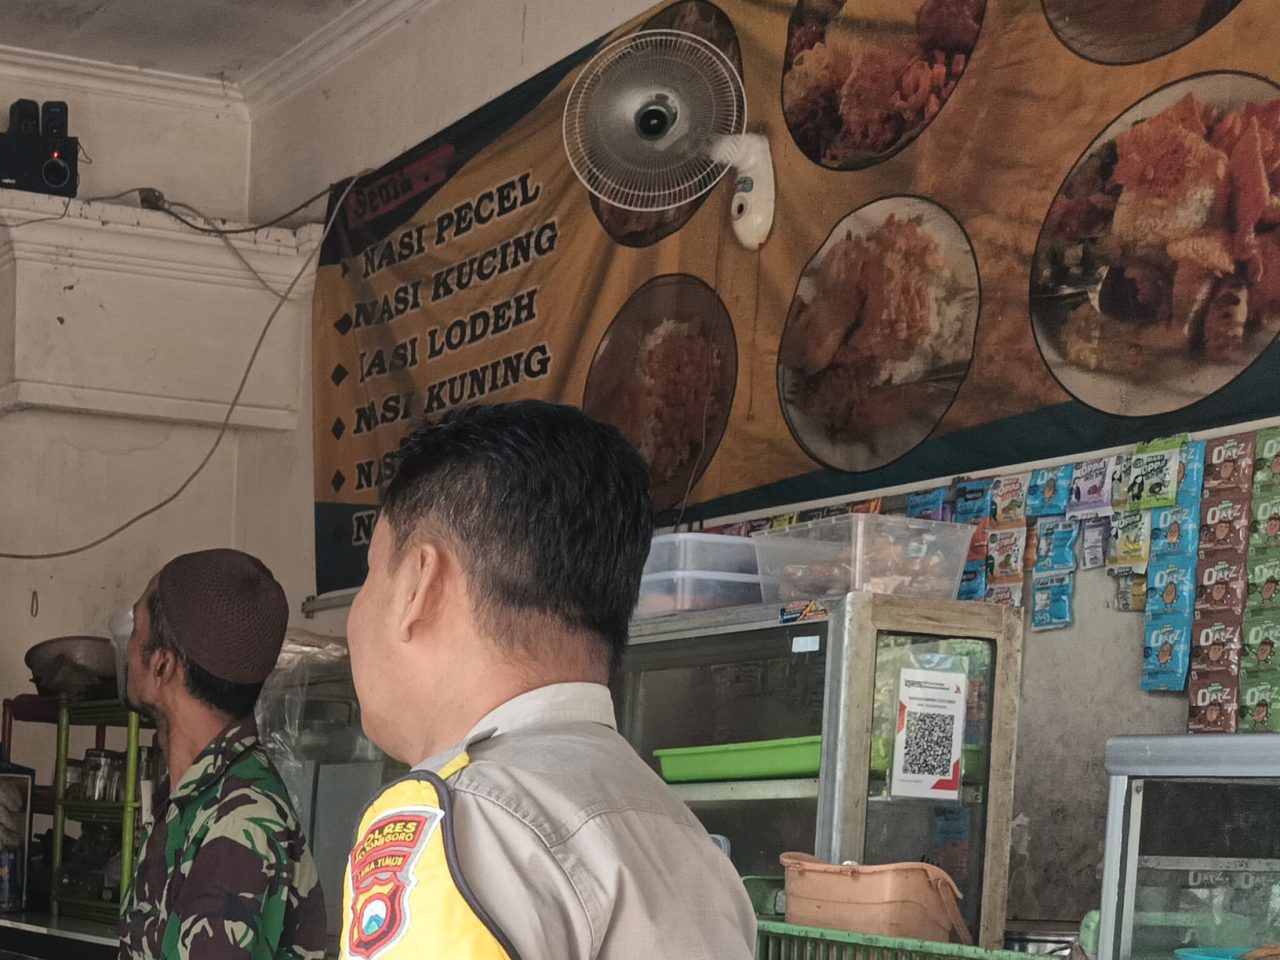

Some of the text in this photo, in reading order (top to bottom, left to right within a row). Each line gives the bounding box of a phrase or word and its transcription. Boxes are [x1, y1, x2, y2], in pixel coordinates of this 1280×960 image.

[362, 173, 540, 279] NASI PECEL
[353, 221, 558, 329] NASI KUCING
[427, 289, 538, 360] LODEH
[424, 343, 551, 414] KUNING
